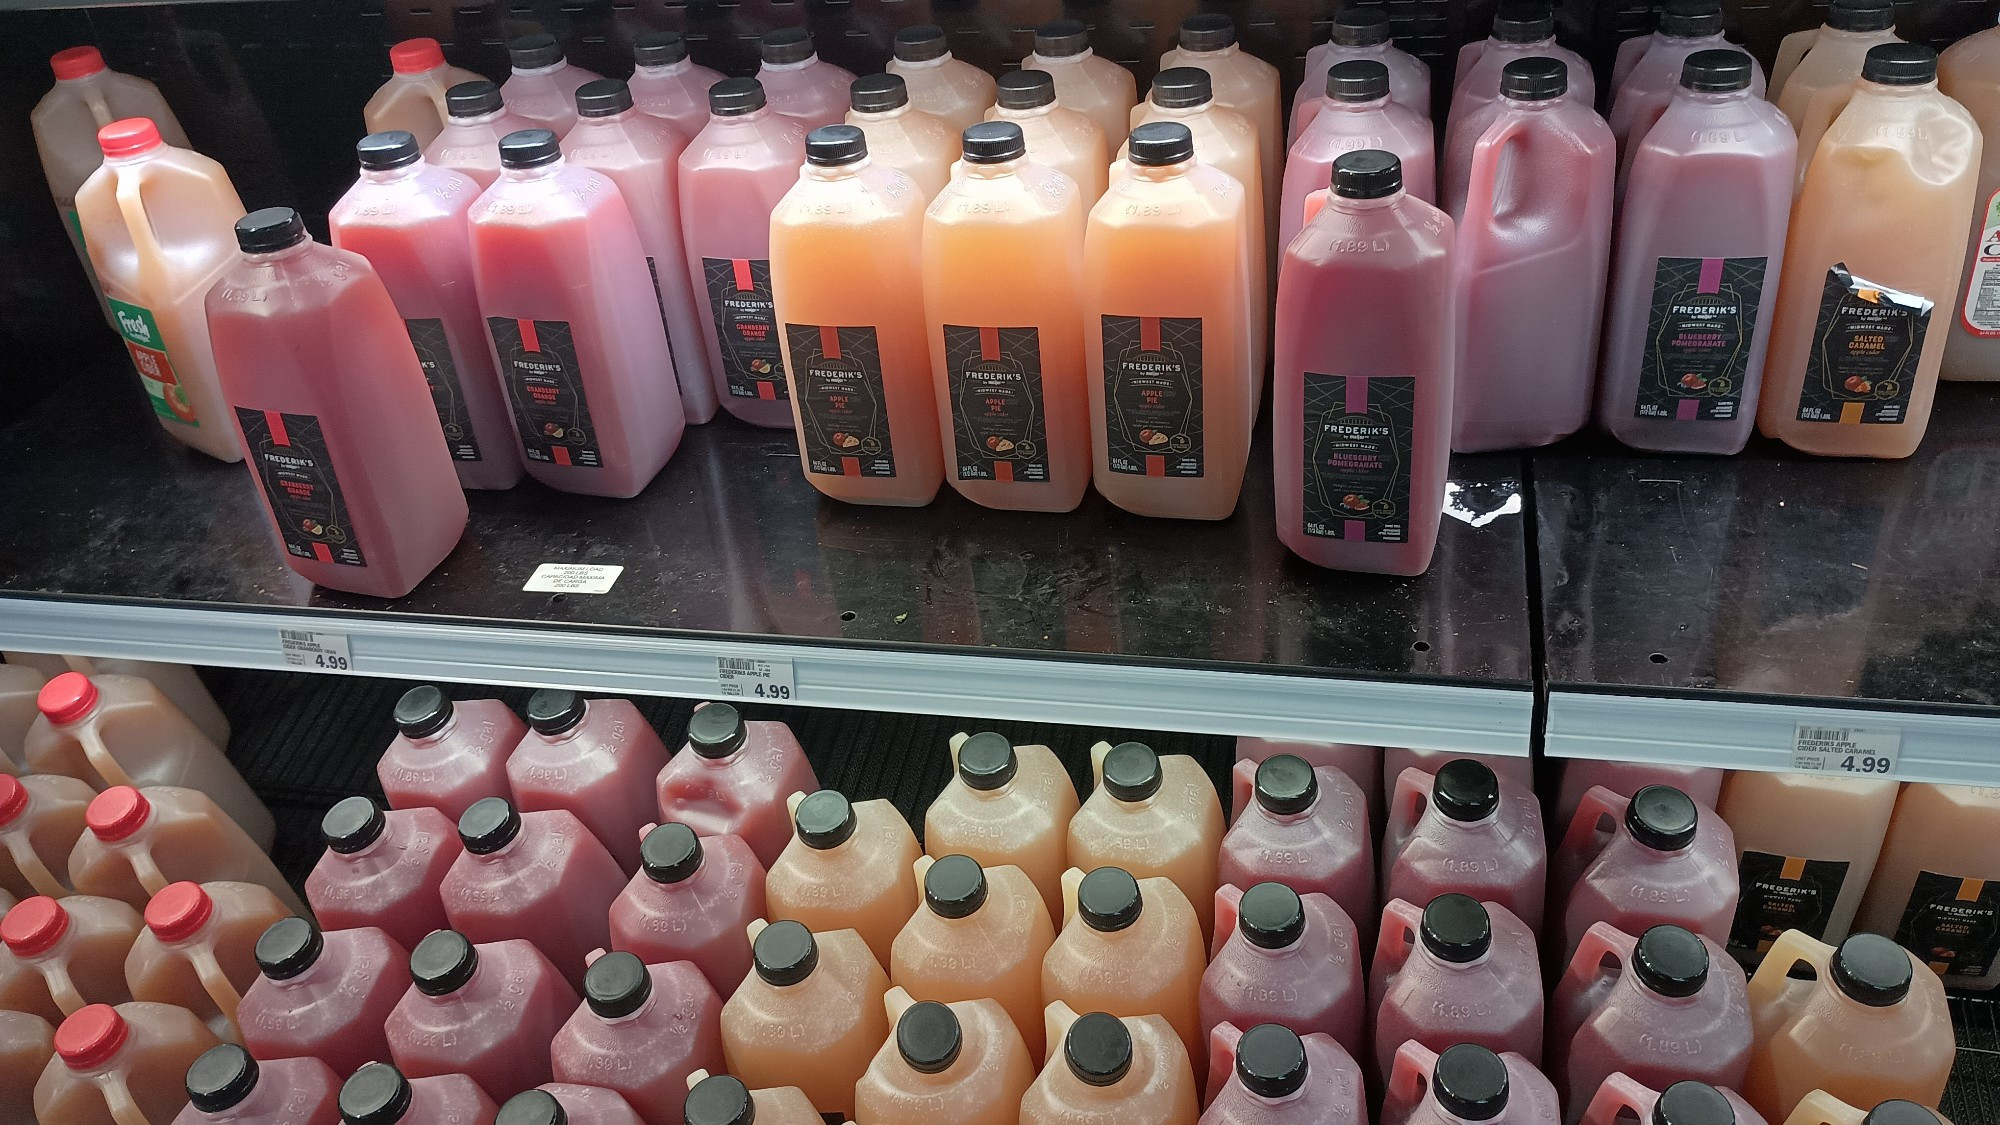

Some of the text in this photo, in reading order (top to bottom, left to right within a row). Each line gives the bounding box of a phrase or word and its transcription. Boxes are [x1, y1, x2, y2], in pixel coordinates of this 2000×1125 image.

[1328, 238, 1368, 253] (1.89
[725, 300, 773, 309] FREDERIK'S
[1672, 306, 1736, 314] FREDERIK'S
[117, 310, 150, 339] Fresh
[1854, 335, 1884, 343] SALTED
[1848, 342, 1885, 350] CARAMEL
[514, 361, 561, 372] FREDERIK'S
[1122, 362, 1181, 372] FREDERIK'S
[809, 369, 862, 379] FREDERIK'S
[966, 372, 1021, 381] FREDERIK'S
[527, 386, 560, 394] CRANBERRY
[1141, 389, 1162, 397] APPLE
[533, 392, 556, 400] ORANGE
[1324, 424, 1389, 435] FREDERIK'S
[264, 454, 313, 467] FREDERIK'S
[1334, 452, 1377, 462] BLUEBERRY
[1327, 459, 1383, 469] POMEGRANATE
[316, 654, 347, 670] 4.99
[755, 683, 790, 699] 4.99
[1840, 756, 1890, 774] 4.99
[1443, 857, 1479, 872] (1.89
[1756, 882, 1817, 896] FREDERIK'S
[1763, 905, 1797, 913] CARAMEL
[1767, 901, 1795, 909] SALTED
[1930, 903, 1994, 916] FREDERIK'S
[1935, 927, 1971, 935] CARAMEL
[1941, 922, 1969, 930] SALTED
[1243, 984, 1278, 1002] (1.89
[1639, 1034, 1680, 1053] (1.89
